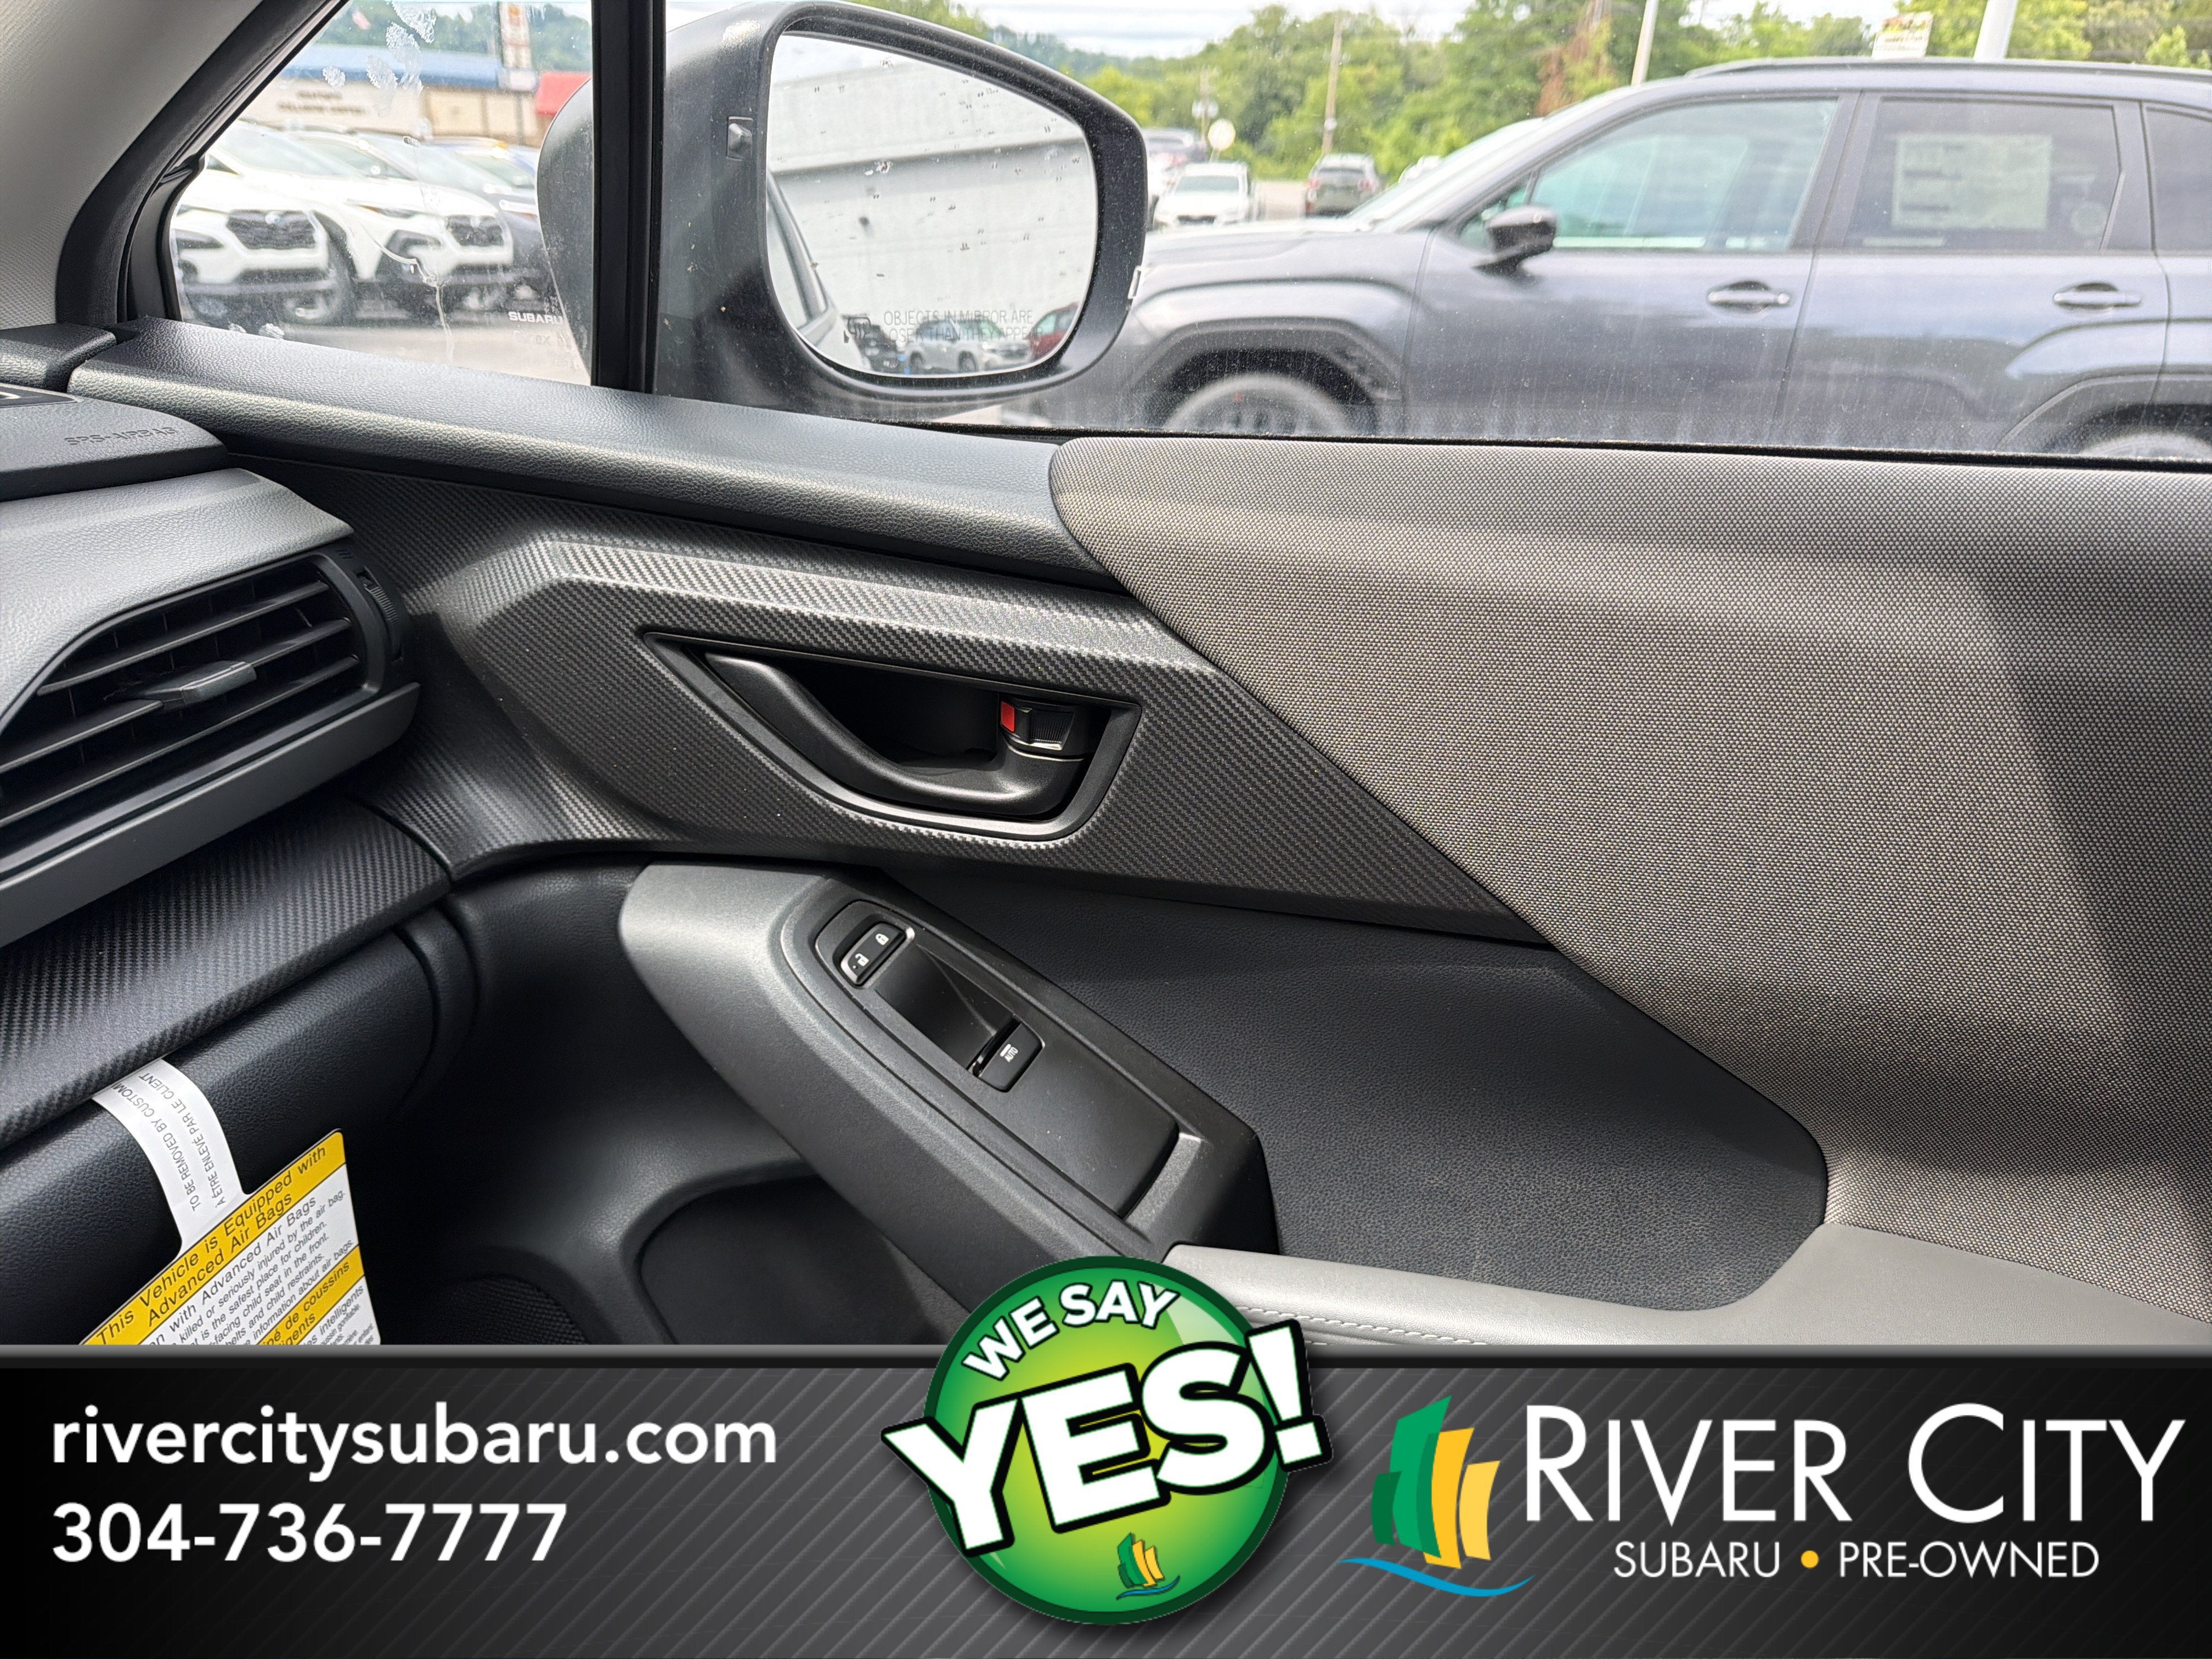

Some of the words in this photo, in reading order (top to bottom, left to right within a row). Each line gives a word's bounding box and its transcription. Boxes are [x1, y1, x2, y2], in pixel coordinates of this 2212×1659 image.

[508, 311, 563, 325] SUBARU
[883, 310, 939, 326] OBJECTS
[944, 311, 957, 324] IN
[959, 310, 1007, 325] MIRROR
[1011, 310, 1034, 324] ARE
[1005, 1047, 1018, 1063] AUTO
[138, 1073, 174, 1099] CLIENT
[171, 1098, 187, 1114] LE
[151, 1118, 167, 1133] BY
[182, 1112, 200, 1135] PAR
[162, 1132, 191, 1181] REMOVED
[191, 1133, 215, 1172] ENLEVÉ
[184, 1179, 196, 1195] BE
[189, 1194, 201, 1211] TO
[95, 1310, 134, 1345] This
[139, 1252, 199, 1308] Vehicle
[204, 1235, 218, 1254] is
[224, 1170, 292, 1237] Equipped
[297, 1147, 326, 1175] with
[149, 1248, 225, 1328] Advanced
[230, 1227, 251, 1254] Air
[255, 1193, 292, 1230] Bags
[169, 1304, 197, 1333] with
[202, 1242, 262, 1306] Advanced
[267, 1224, 282, 1246] Air
[286, 1197, 317, 1227] Bags
[179, 1314, 204, 1344] killed
[205, 1305, 216, 1319] or
[218, 1268, 255, 1307] seriously
[257, 1239, 286, 1271] injured
[287, 1229, 298, 1244] by
[300, 1216, 313, 1232] the
[315, 1204, 326, 1218] air
[328, 1190, 346, 1208] bag.
[201, 1329, 210, 1341] is
[211, 1313, 227, 1330] the
[228, 1285, 255, 1314] safest
[256, 1263, 278, 1291] place
[280, 1250, 292, 1265] for
[294, 1220, 328, 1252] children.
[242, 1293, 262, 1317] child
[264, 1274, 283, 1297] seat
[284, 1267, 292, 1278] in
[294, 1252, 307, 1268] the
[309, 1232, 329, 1254] front.
[249, 1307, 264, 1329] and
[266, 1286, 285, 1311] child
[287, 1252, 325, 1290] restraints.
[252, 1293, 296, 1341] information
[298, 1269, 320, 1296] about
[321, 1257, 332, 1273] air
[285, 1312, 300, 1330] de
[303, 1261, 350, 1312] coussins
[319, 1285, 364, 1335] intelligents
